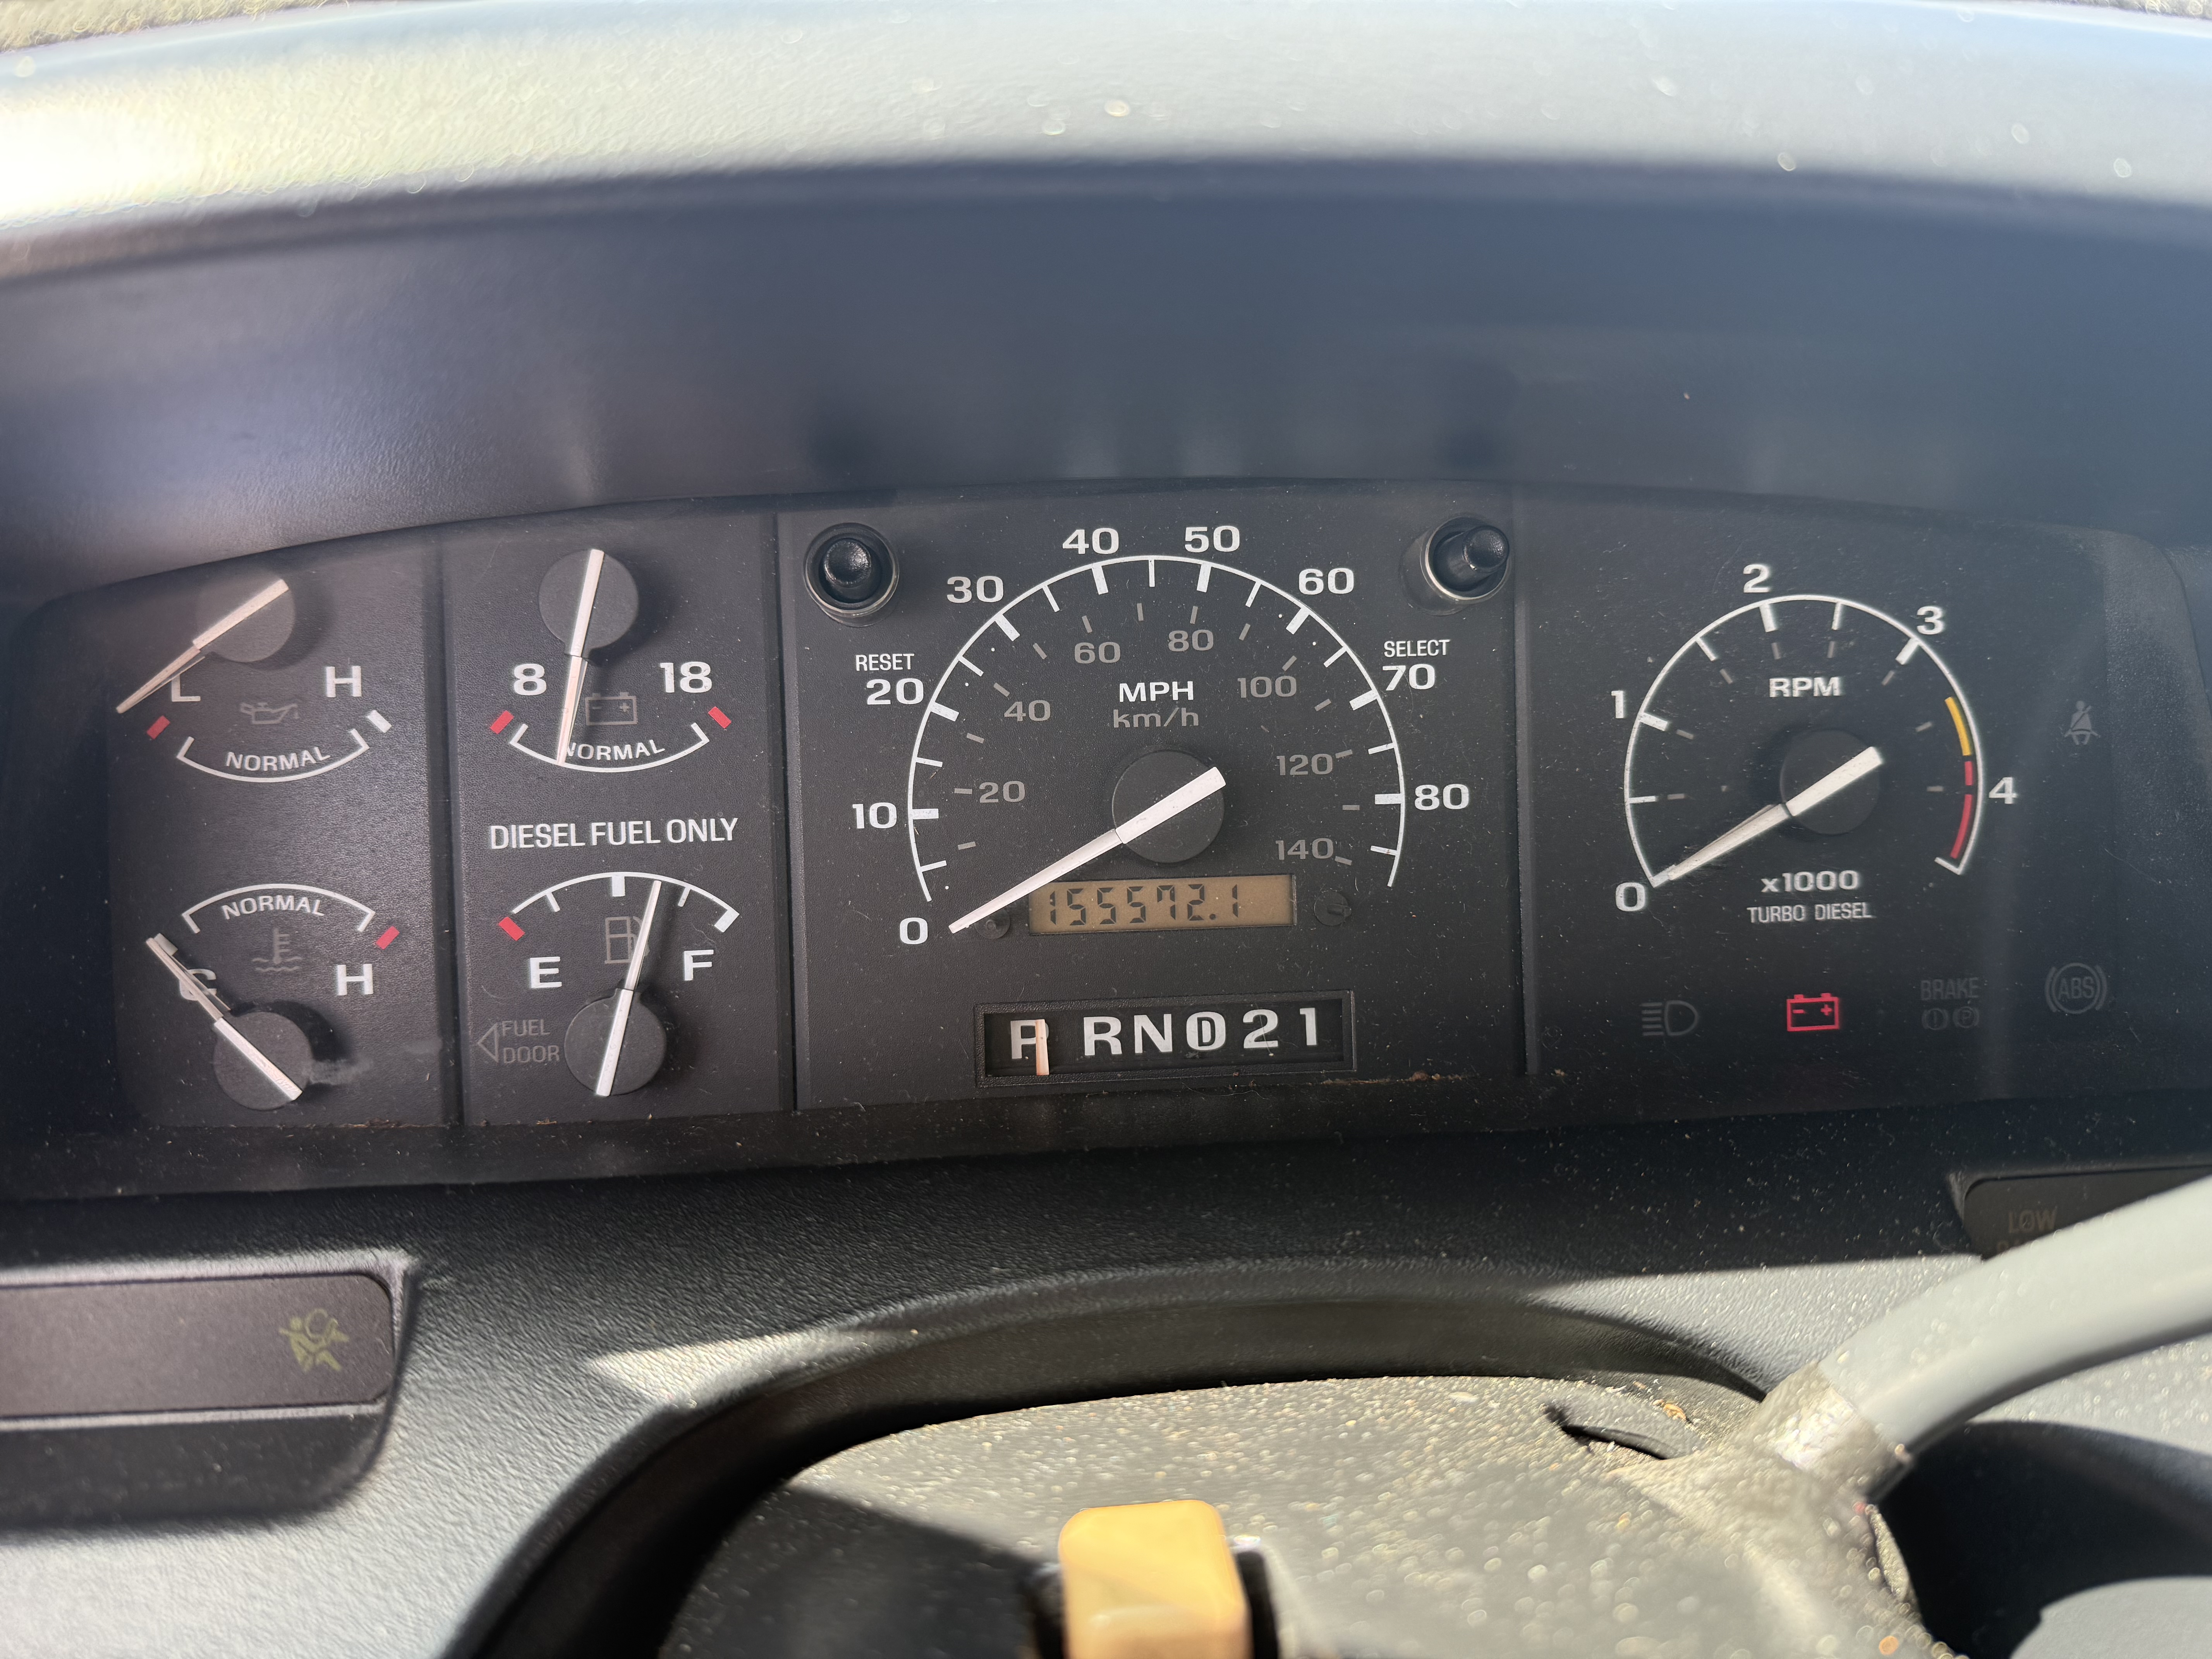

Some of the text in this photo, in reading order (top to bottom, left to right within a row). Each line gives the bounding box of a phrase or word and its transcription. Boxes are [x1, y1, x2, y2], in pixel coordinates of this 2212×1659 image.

[1062, 527, 1119, 555] 40
[1185, 526, 1240, 553] 50
[946, 575, 1004, 603] 30
[1298, 568, 1354, 594] 60
[1743, 564, 1772, 593] 2
[1917, 606, 1945, 635] 3
[1074, 642, 1120, 664] 60
[1168, 629, 1214, 651] 80
[1383, 639, 1450, 658] SELECT
[856, 654, 914, 671] RESET
[172, 675, 200, 702] L
[326, 666, 361, 697] H
[514, 663, 546, 696] 8
[660, 661, 712, 693] 18
[1237, 676, 1297, 698] 100
[1382, 663, 1435, 691] 70
[1769, 677, 1841, 697] RPM
[866, 678, 924, 705] 20
[1119, 681, 1194, 702] MPH
[1611, 690, 1626, 718] 1
[1004, 700, 1051, 722] 40
[1113, 708, 1199, 728] km/h
[226, 747, 330, 772] NORMAL
[1276, 753, 1333, 776] 120
[979, 781, 1025, 804] 20
[1414, 783, 1469, 810] 80
[1989, 777, 2017, 804] 4
[852, 802, 897, 829] 10
[491, 817, 738, 849] DIESEL FUEL ONLY
[1275, 838, 1334, 860] 140
[1761, 870, 1859, 893] x1000
[222, 895, 325, 920] NORMAL
[1049, 883, 1238, 926] 155572.1
[1615, 881, 1646, 911] 0
[1747, 902, 1873, 923] TURBO DIESEL
[899, 917, 928, 945] 0
[529, 956, 562, 989] E
[684, 950, 714, 981] F
[336, 963, 374, 996] H
[1921, 977, 1979, 1000] BRAKE
[2058, 976, 2094, 999] ABS
[501, 1019, 550, 1036] FUEL
[1084, 1016, 1122, 1056] R
[1134, 1013, 1173, 1053] N
[1243, 1008, 1279, 1049] 2
[1299, 1007, 1317, 1046] 1
[503, 1045, 560, 1063] DOOR
[2008, 1205, 2058, 1234] LOW
